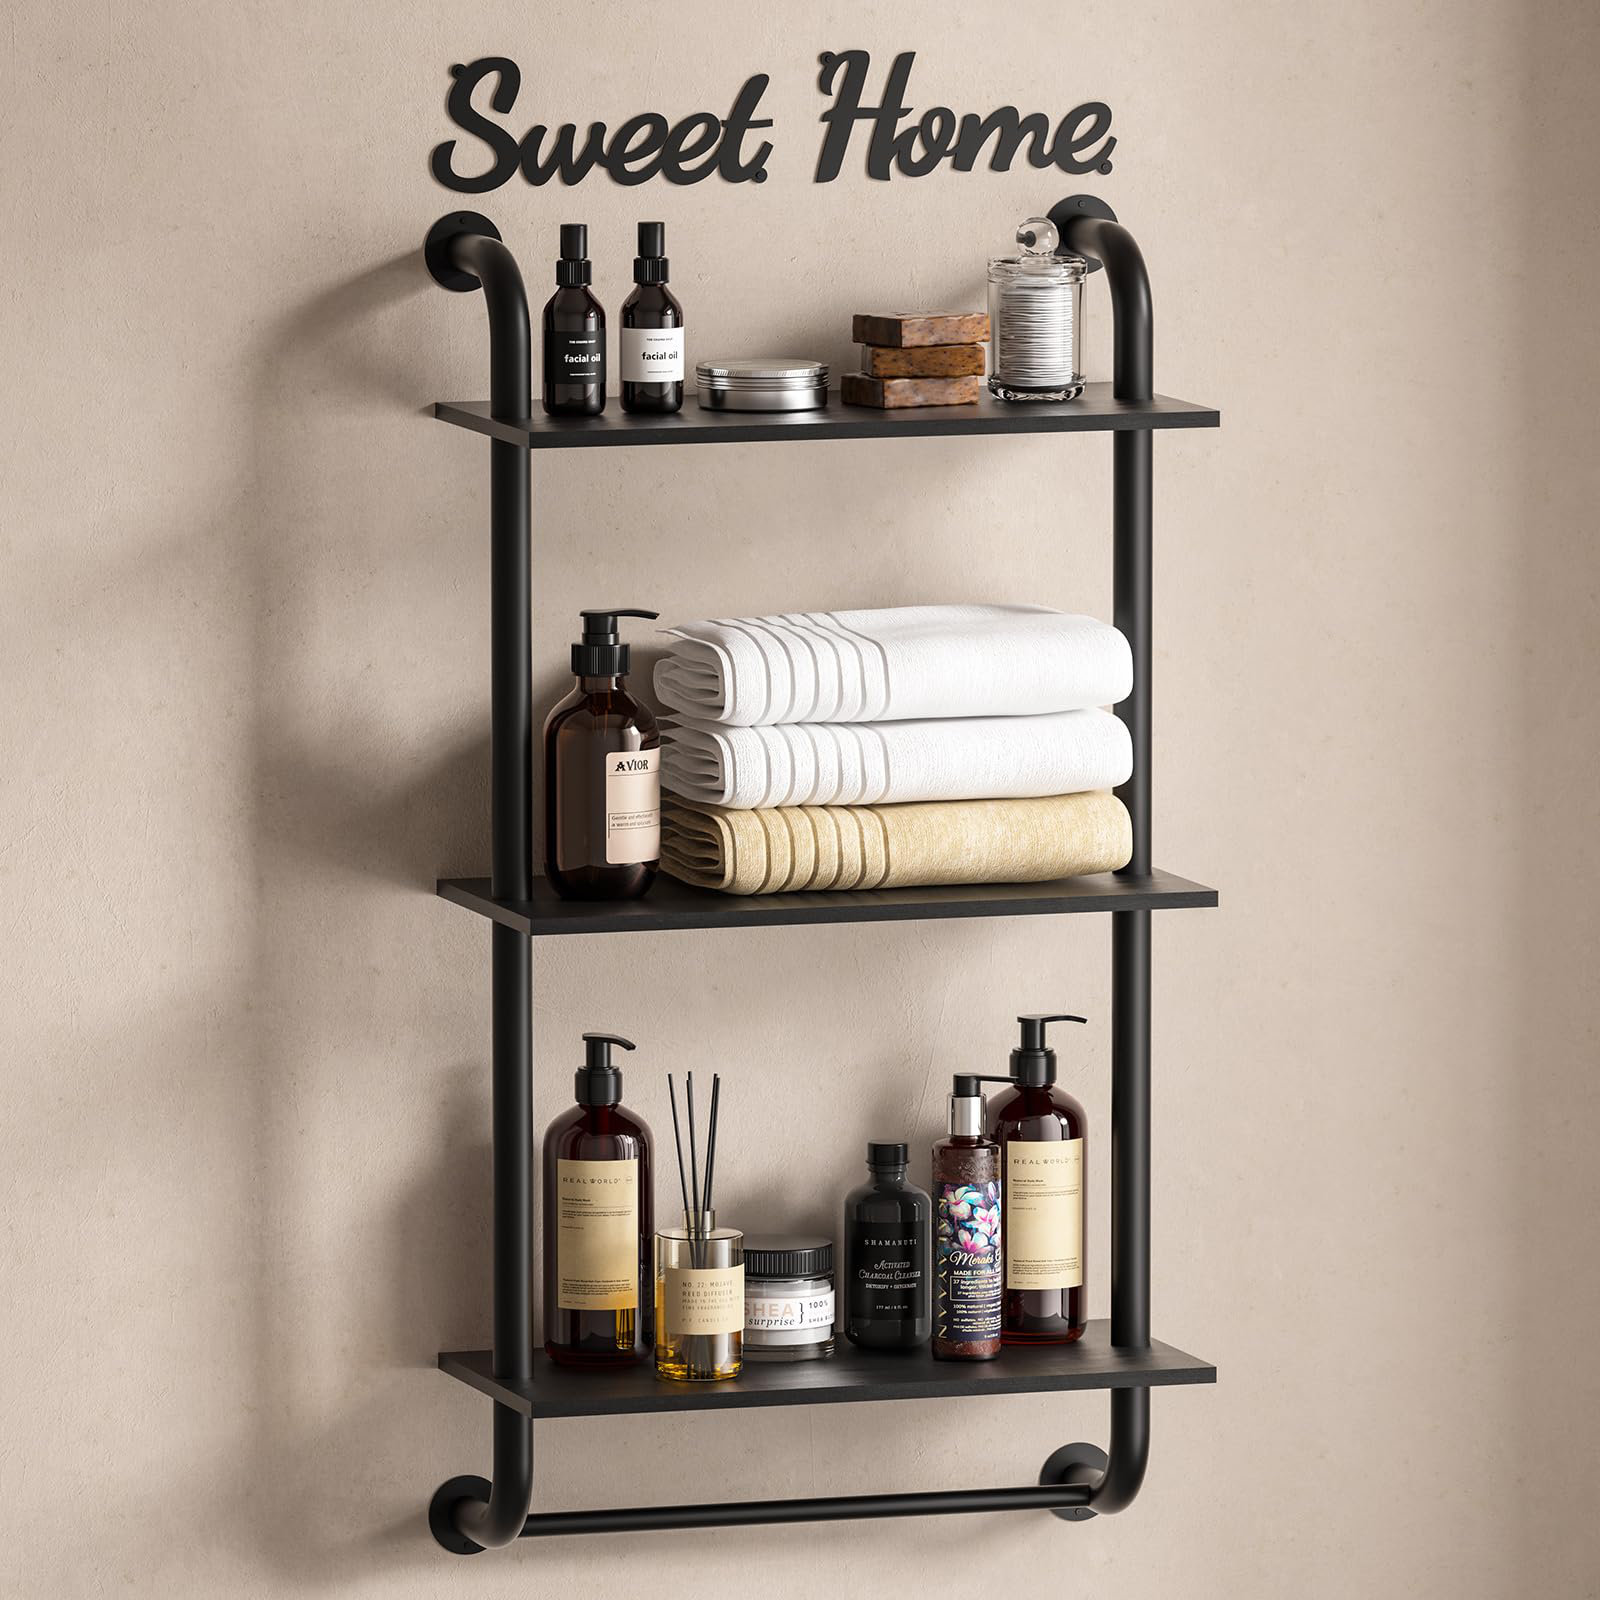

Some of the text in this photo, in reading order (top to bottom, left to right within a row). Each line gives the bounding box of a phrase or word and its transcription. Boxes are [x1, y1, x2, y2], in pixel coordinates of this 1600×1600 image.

[432, 51, 1116, 193] Sweet Home
[564, 353, 601, 363] facial oil
[641, 350, 678, 361] facial oil
[614, 759, 650, 772] AVIOR
[949, 1250, 994, 1267] Meraki
[808, 1300, 829, 1309] 100%
[748, 1317, 795, 1328] surprise
